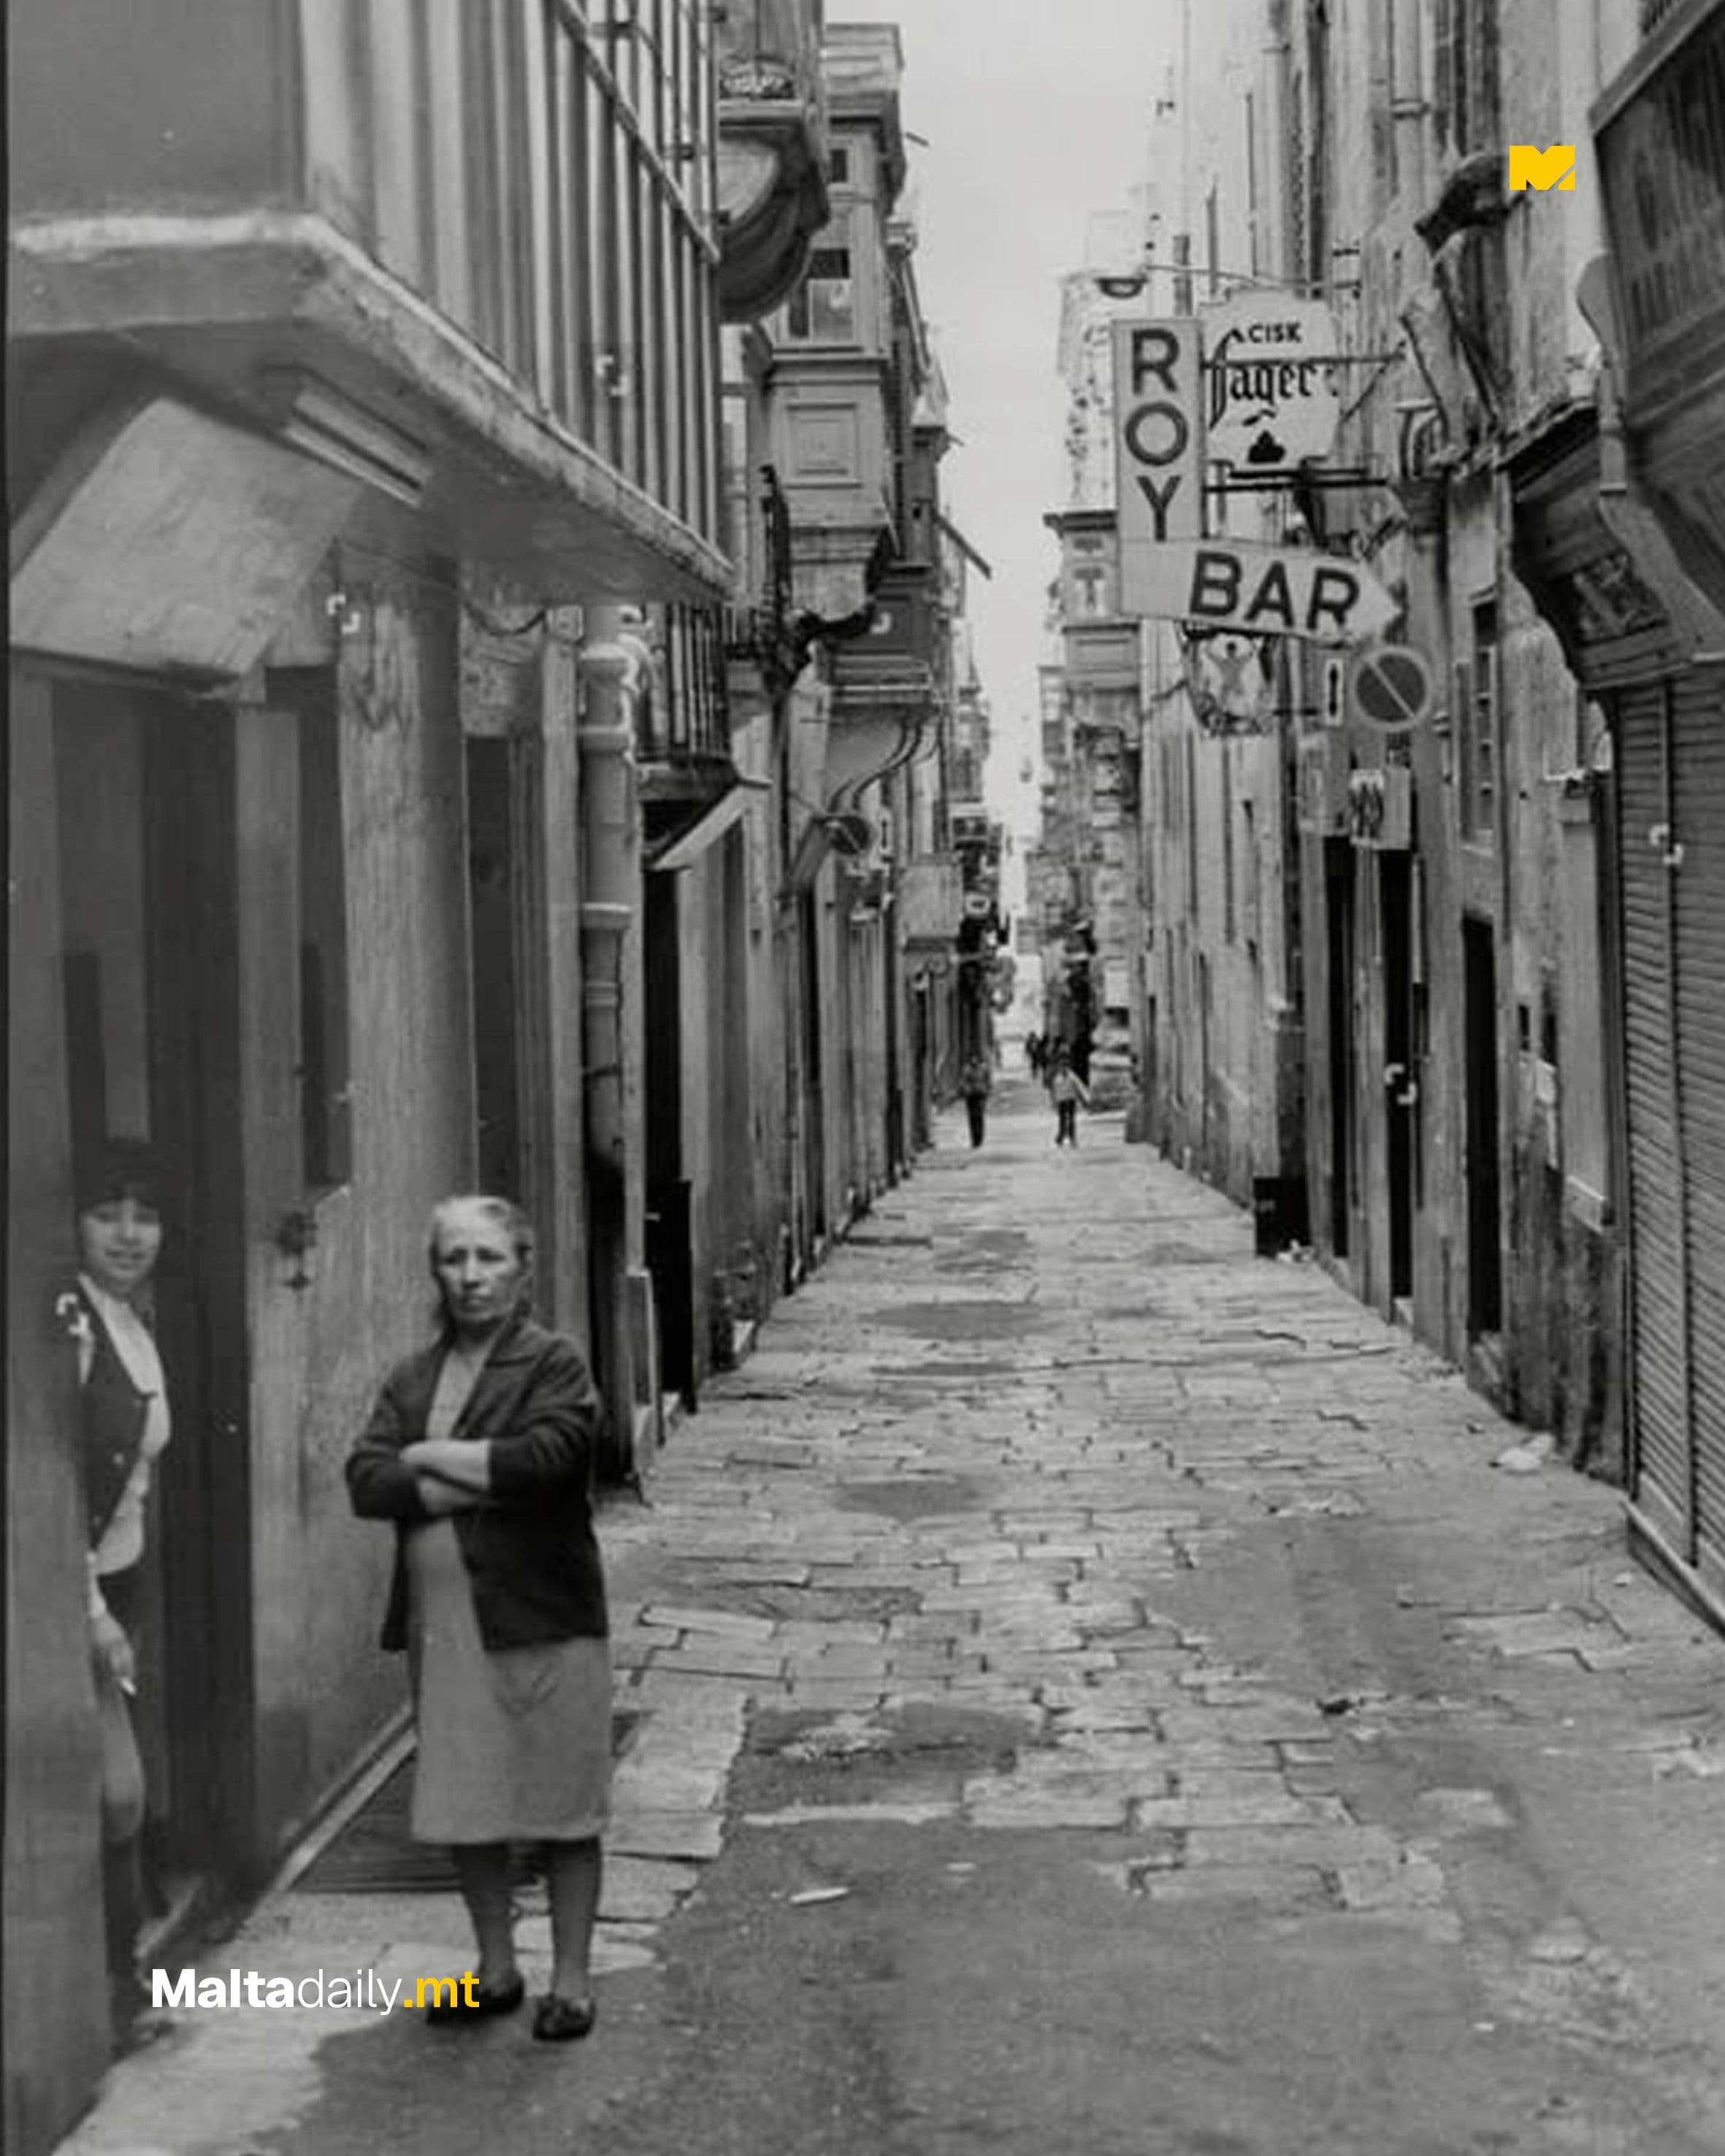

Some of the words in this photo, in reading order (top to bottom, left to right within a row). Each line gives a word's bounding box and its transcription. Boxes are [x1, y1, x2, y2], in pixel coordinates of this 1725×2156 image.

[1248, 322, 1301, 343] CISK
[1125, 328, 1188, 542] ROY
[1189, 550, 1360, 629] BAR
